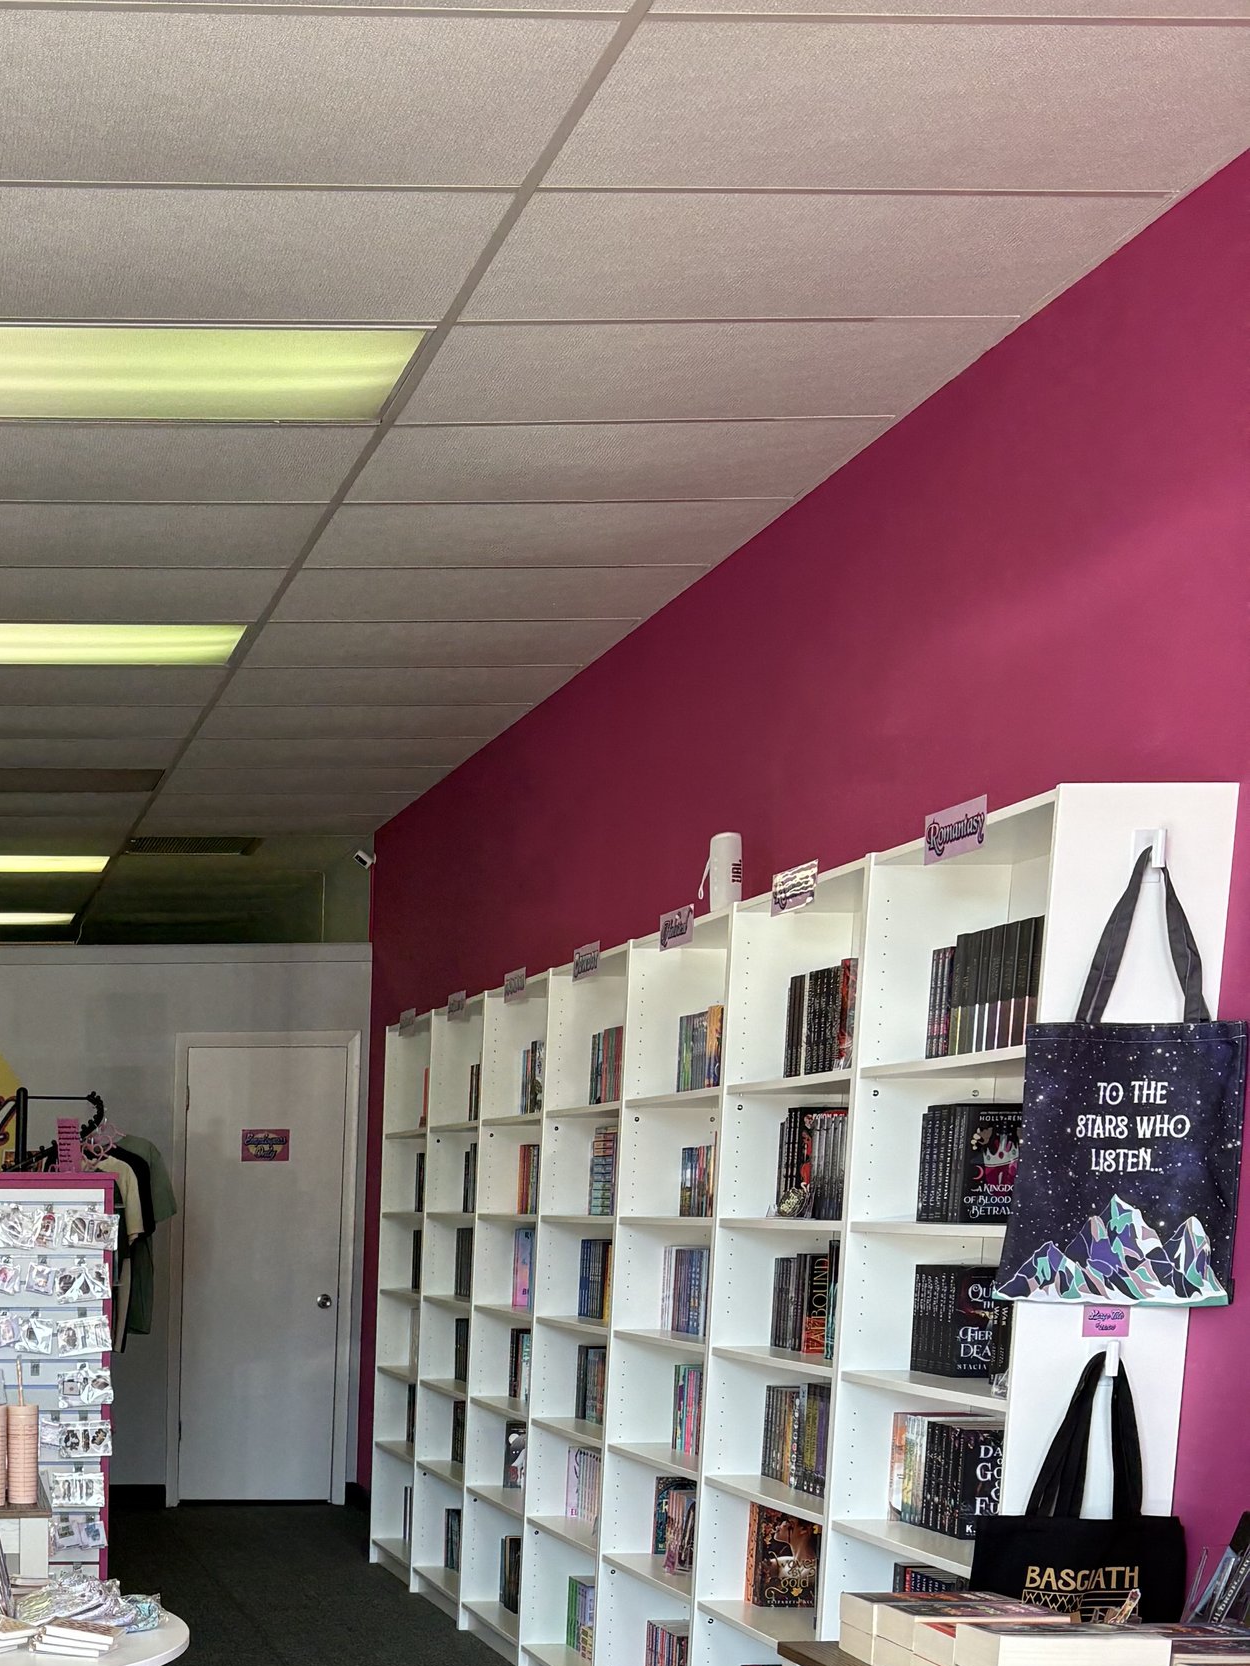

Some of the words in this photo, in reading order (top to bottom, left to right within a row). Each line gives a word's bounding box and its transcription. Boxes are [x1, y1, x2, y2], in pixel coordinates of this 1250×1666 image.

[926, 812, 985, 857] Romantasy
[1096, 1081, 1125, 1106] TO
[1130, 1080, 1169, 1105] THE
[1075, 1114, 1129, 1139] STARS
[1136, 1114, 1191, 1139] WHO
[1090, 1147, 1163, 1173] LISTEN...
[964, 1196, 976, 1204] OF
[977, 1195, 1011, 1206] BLOOD
[1024, 1565, 1140, 1592] BASGIATH
